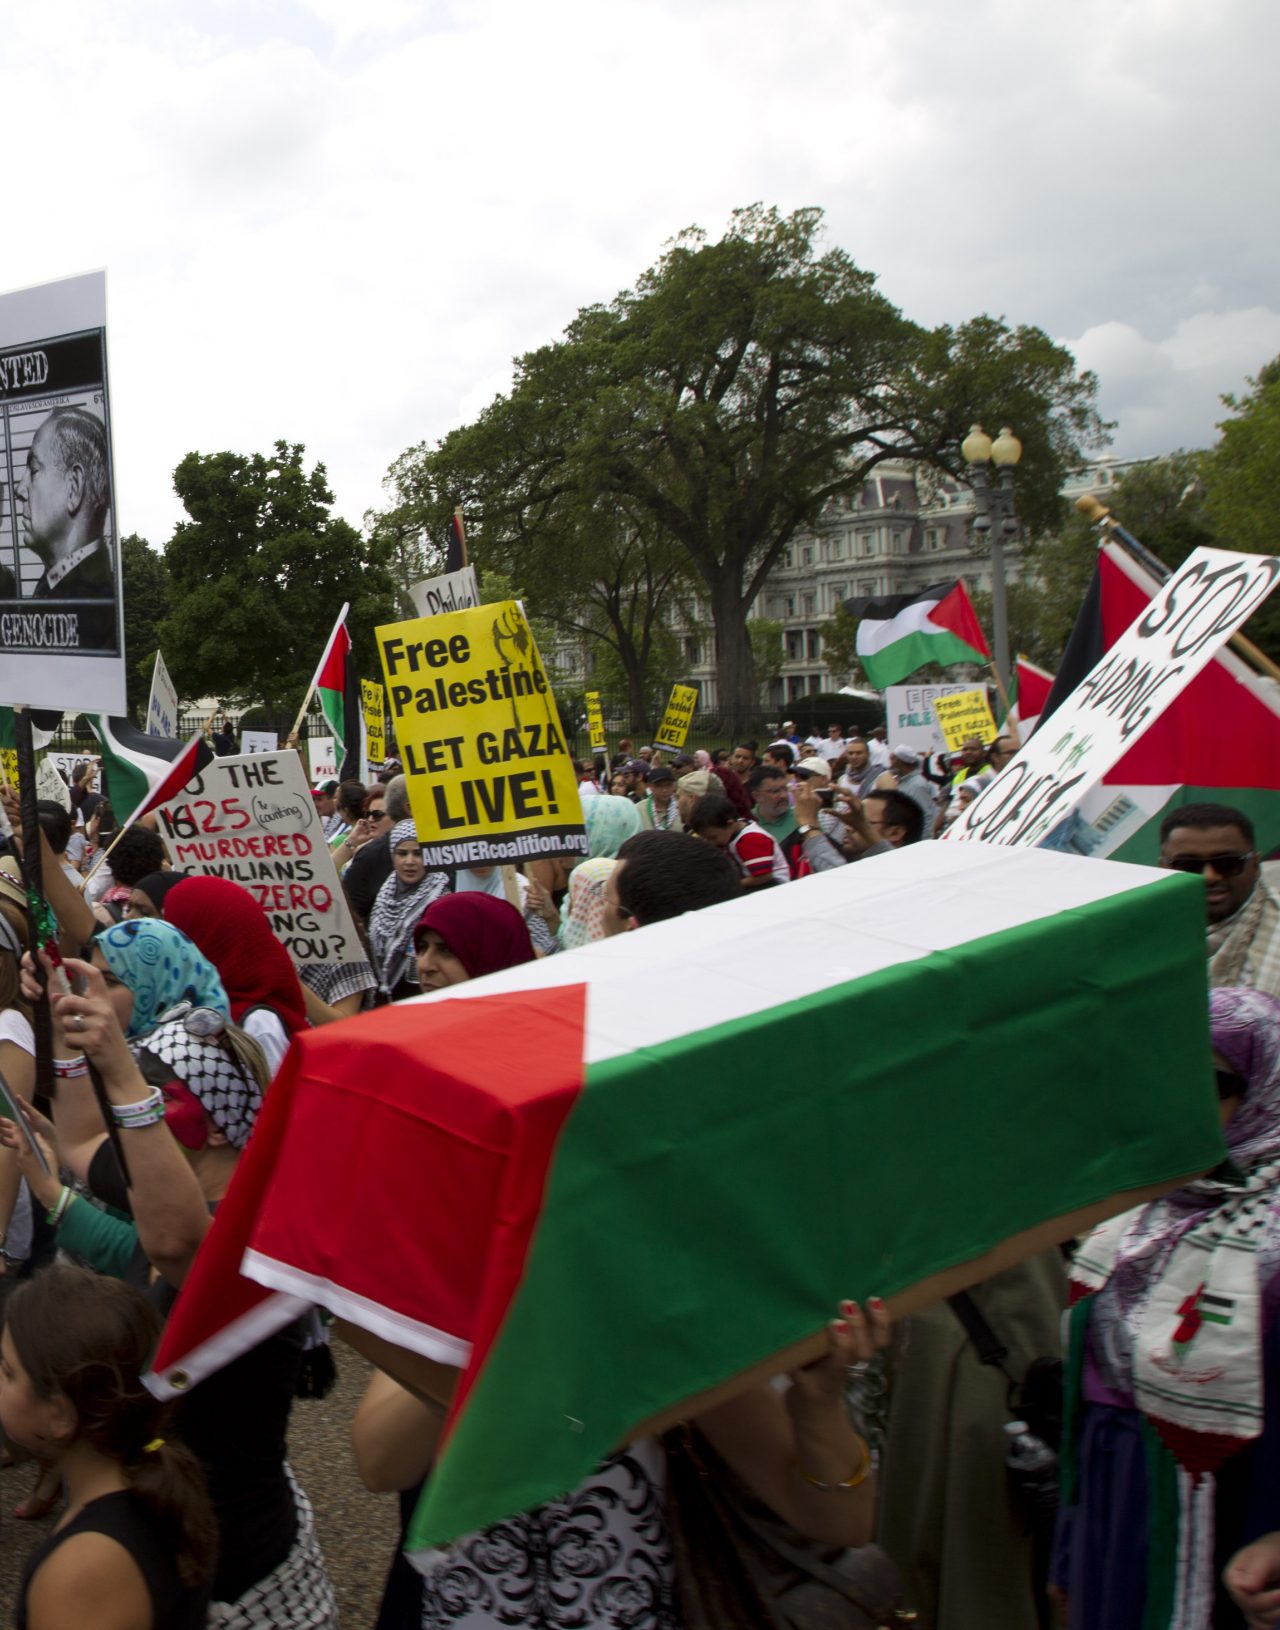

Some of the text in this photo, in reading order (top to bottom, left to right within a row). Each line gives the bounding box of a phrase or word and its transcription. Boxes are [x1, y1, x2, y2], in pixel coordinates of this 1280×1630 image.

[1138, 559, 1280, 659] STOP
[0, 613, 80, 647] GENOCIDE
[382, 634, 471, 676] Free
[391, 663, 548, 718] Palestine
[936, 700, 962, 711] Free
[939, 706, 986, 720] Palestine
[945, 719, 993, 735] LET GAZA
[405, 722, 567, 776] LET GAZA
[219, 759, 284, 789] THE
[431, 769, 560, 831] LIVE!
[176, 833, 313, 863] MURDERED
[422, 834, 589, 867] ANSWERcoalition.org
[250, 883, 333, 913] ZERO
